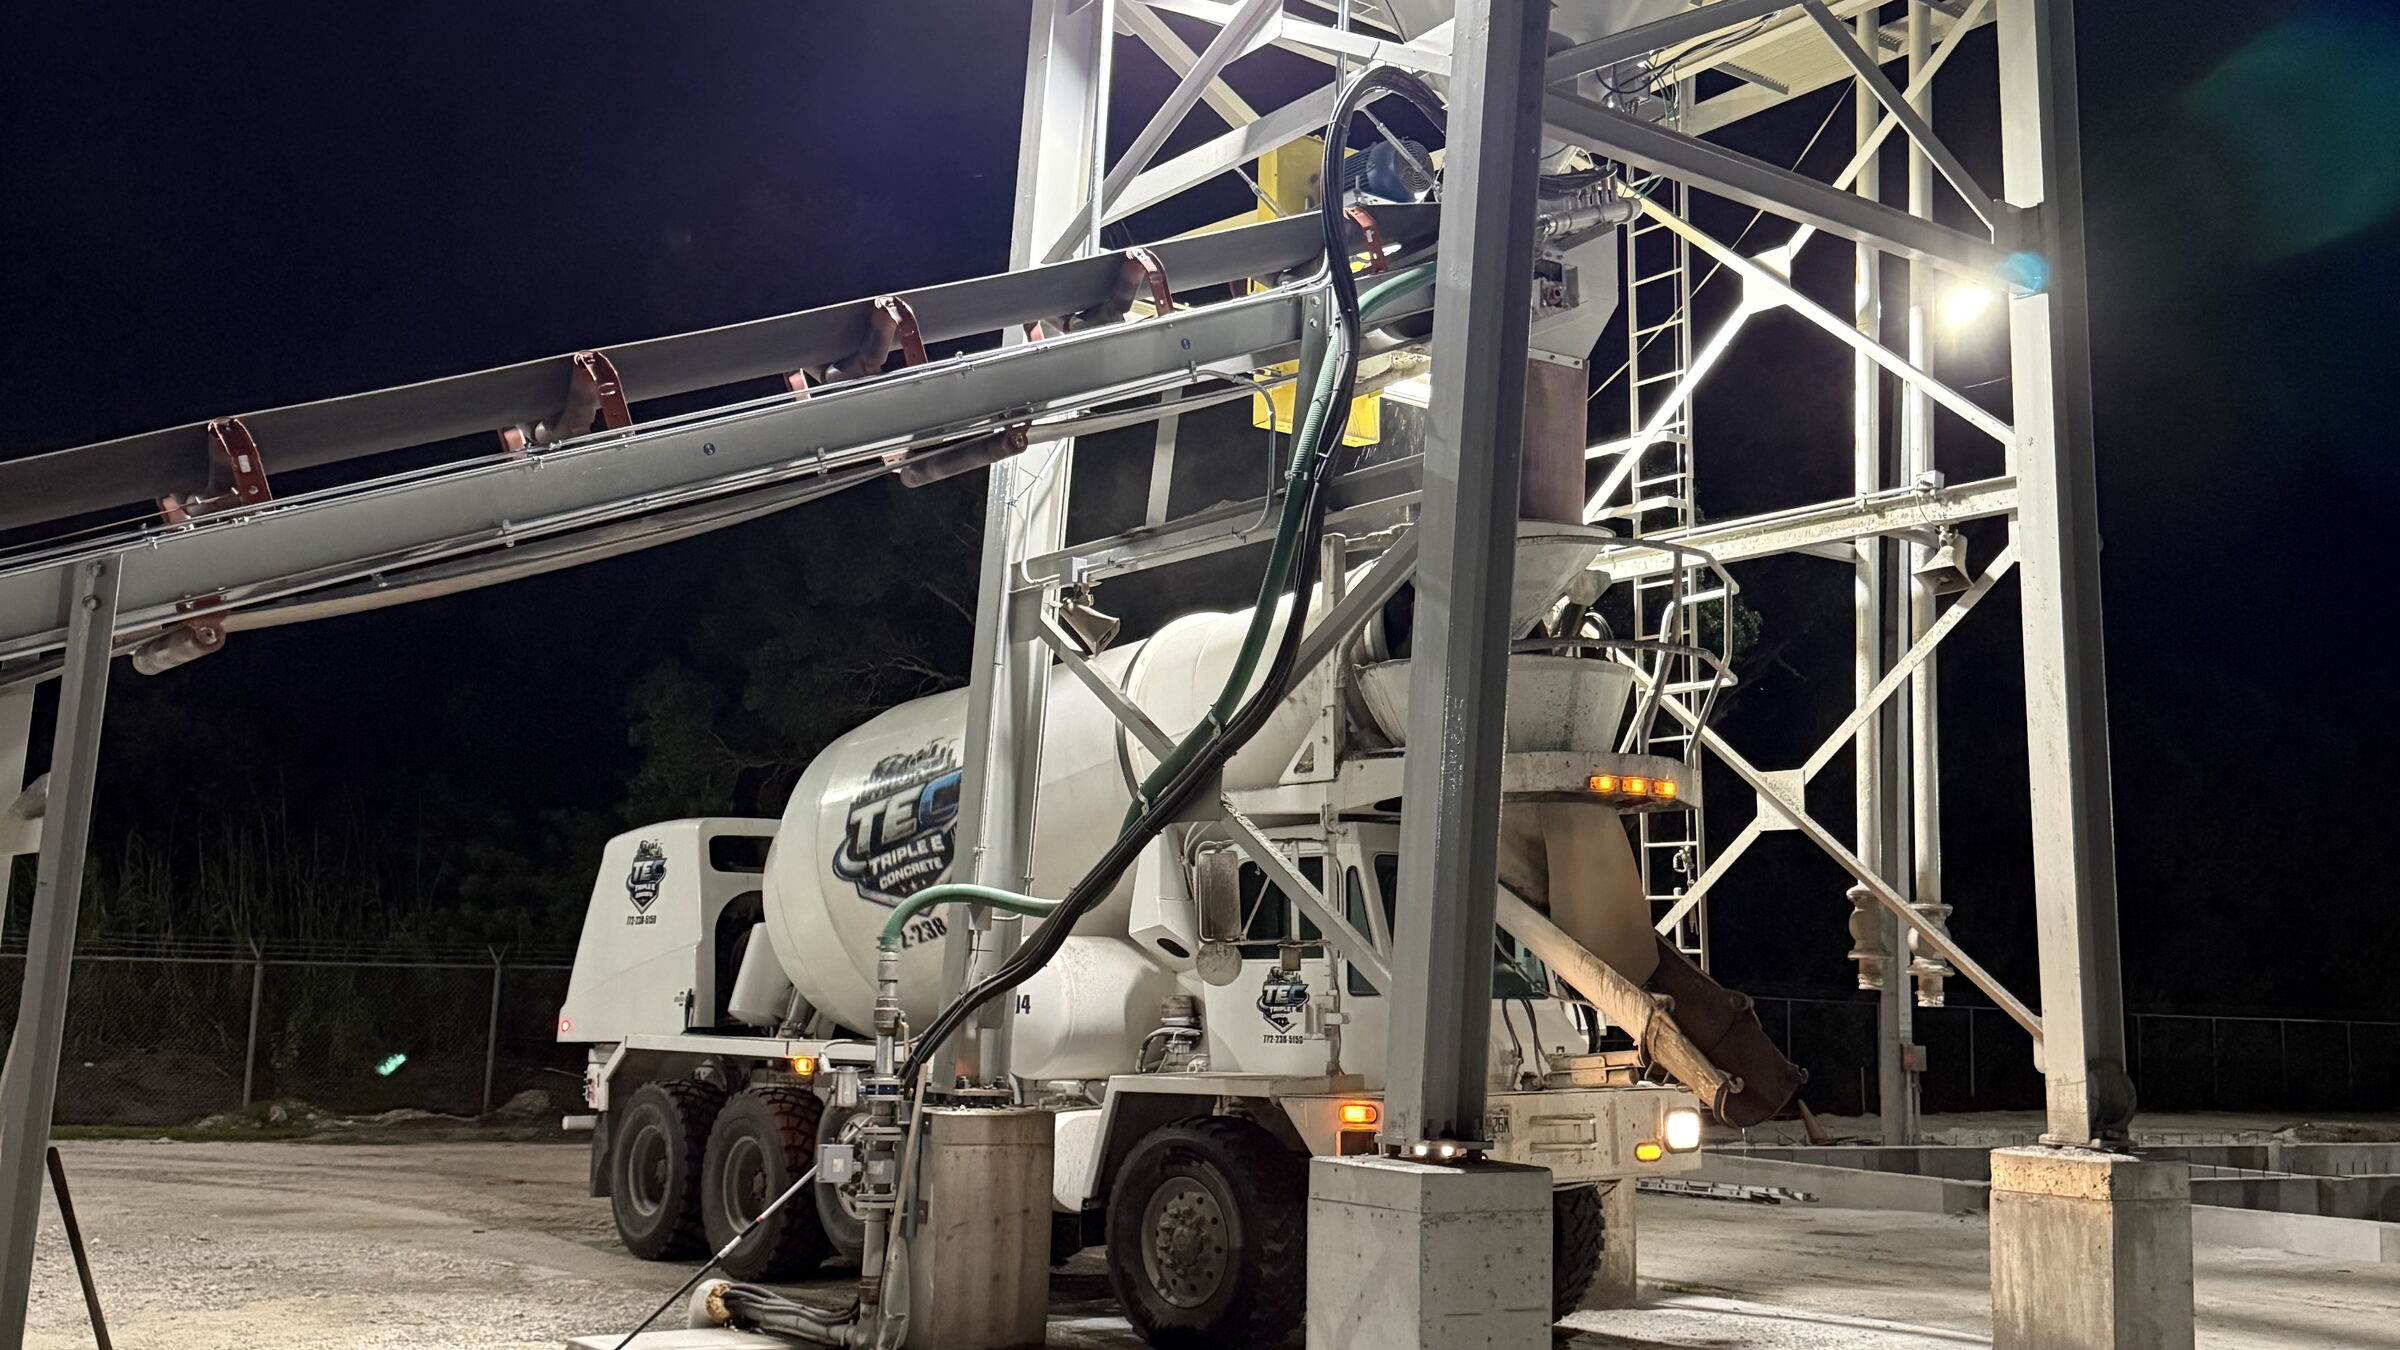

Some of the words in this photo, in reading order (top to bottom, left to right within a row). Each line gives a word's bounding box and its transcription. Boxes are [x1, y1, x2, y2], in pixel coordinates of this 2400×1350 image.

[850, 771, 961, 855] TEC
[869, 840, 929, 876] TRIPLE
[930, 834, 946, 852] E
[633, 860, 667, 882] TEC
[879, 857, 944, 890] CONCRETE
[1016, 994, 1031, 1014] 14
[1263, 984, 1309, 1004] TEC
